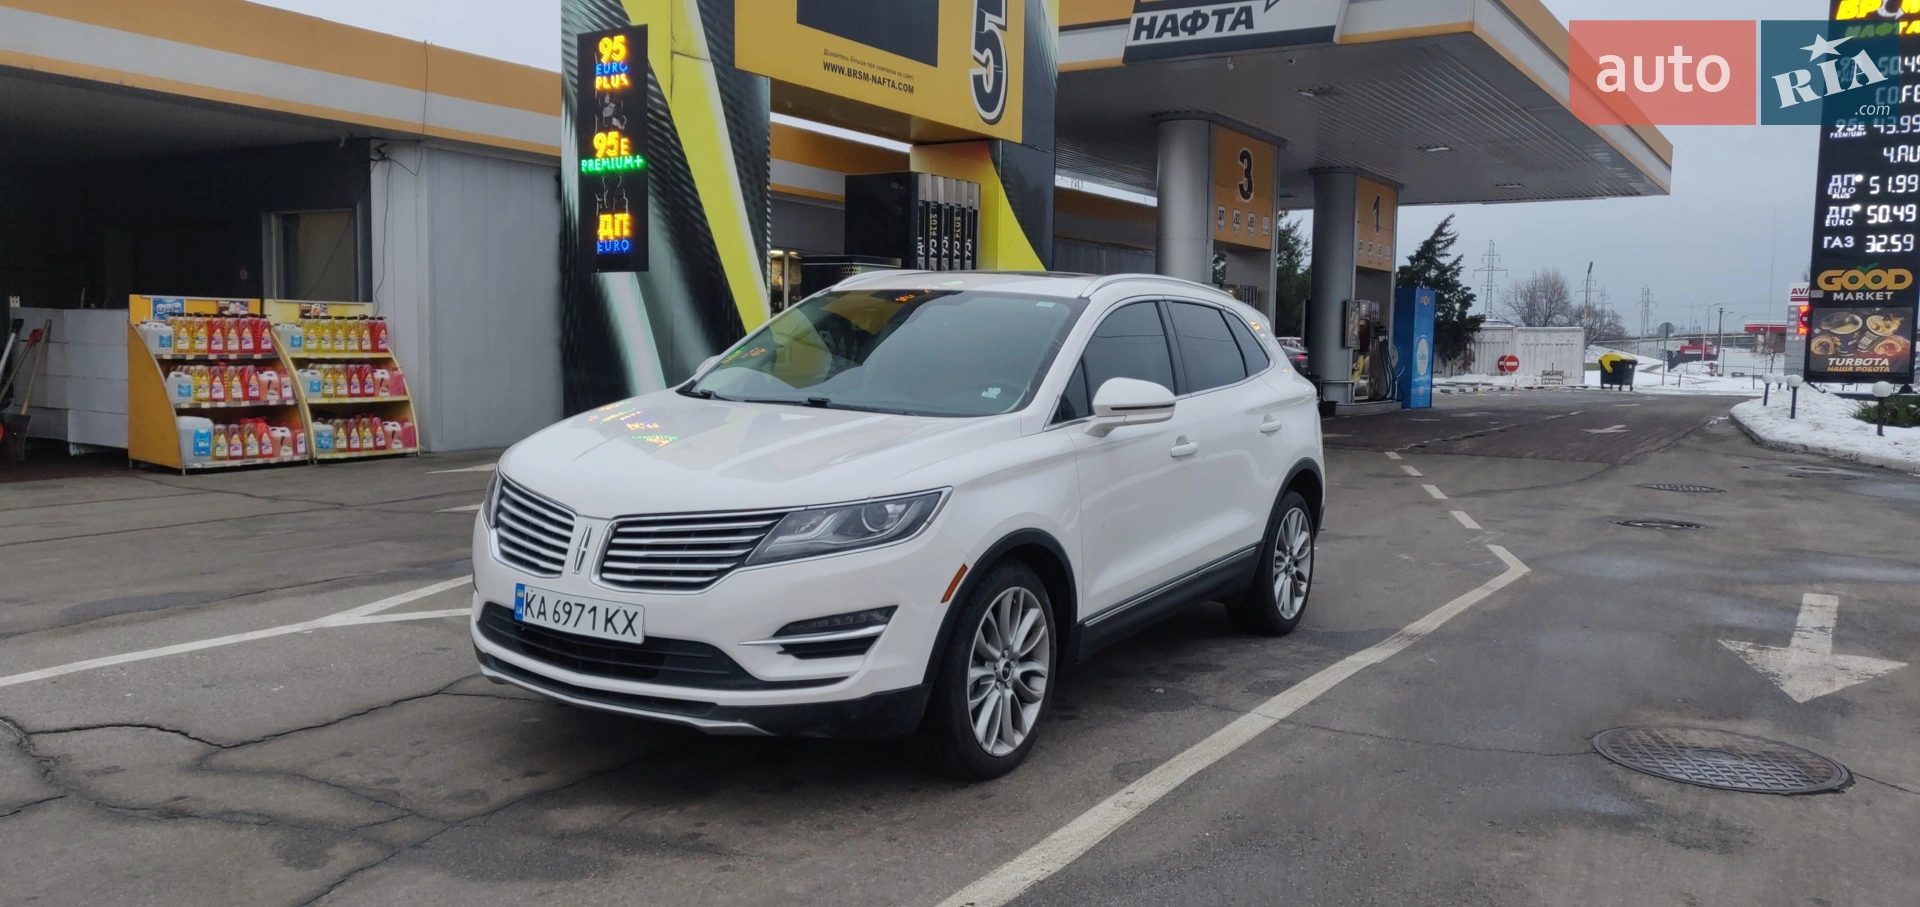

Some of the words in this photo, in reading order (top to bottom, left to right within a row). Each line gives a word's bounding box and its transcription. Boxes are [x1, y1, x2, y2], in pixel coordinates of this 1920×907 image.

[1132, 5, 1254, 41] НАФТА
[599, 35, 627, 63] 95
[596, 61, 628, 74] EURO
[970, 0, 1008, 125] 5
[595, 73, 629, 89] PLUS
[823, 60, 914, 94] WWW.BRSM-NAFTA.COM
[581, 155, 644, 172] PREMIUM+
[1238, 148, 1254, 202] 3
[1373, 193, 1381, 234] 1
[1867, 203, 1917, 224] 50.49
[598, 213, 630, 240] ДП
[597, 240, 629, 253] EURO
[1823, 235, 1855, 248] ГАЗ
[1865, 234, 1914, 252] 32.59
[1817, 268, 1913, 291] GOOD
[1833, 291, 1894, 301] MARKET
[1827, 357, 1889, 366] TURBOTA
[525, 592, 547, 621] KA
[552, 599, 597, 631] 6971
[604, 607, 639, 637] KX
